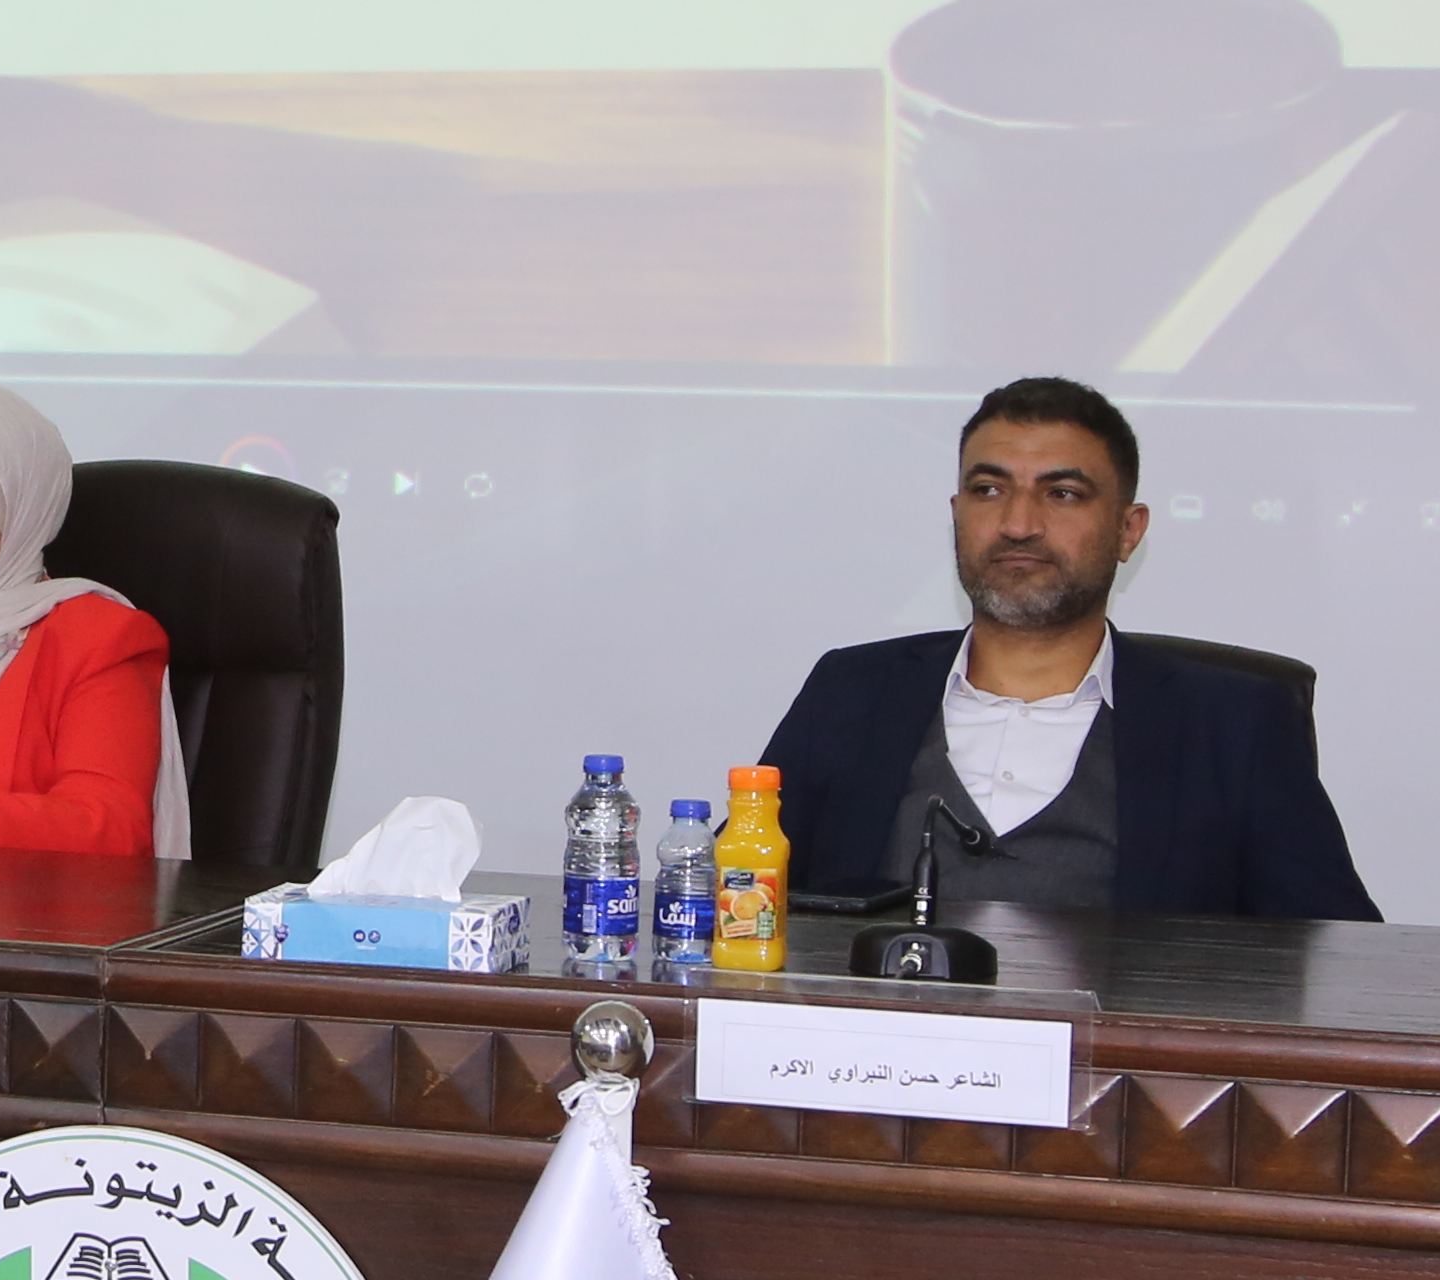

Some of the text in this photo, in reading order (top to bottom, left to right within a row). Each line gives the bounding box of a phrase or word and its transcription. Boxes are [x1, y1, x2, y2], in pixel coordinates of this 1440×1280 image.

[768, 1058, 815, 1079] الاكرم
[899, 1068, 940, 1088] حسن
[945, 1069, 1002, 1090] الشاعر
